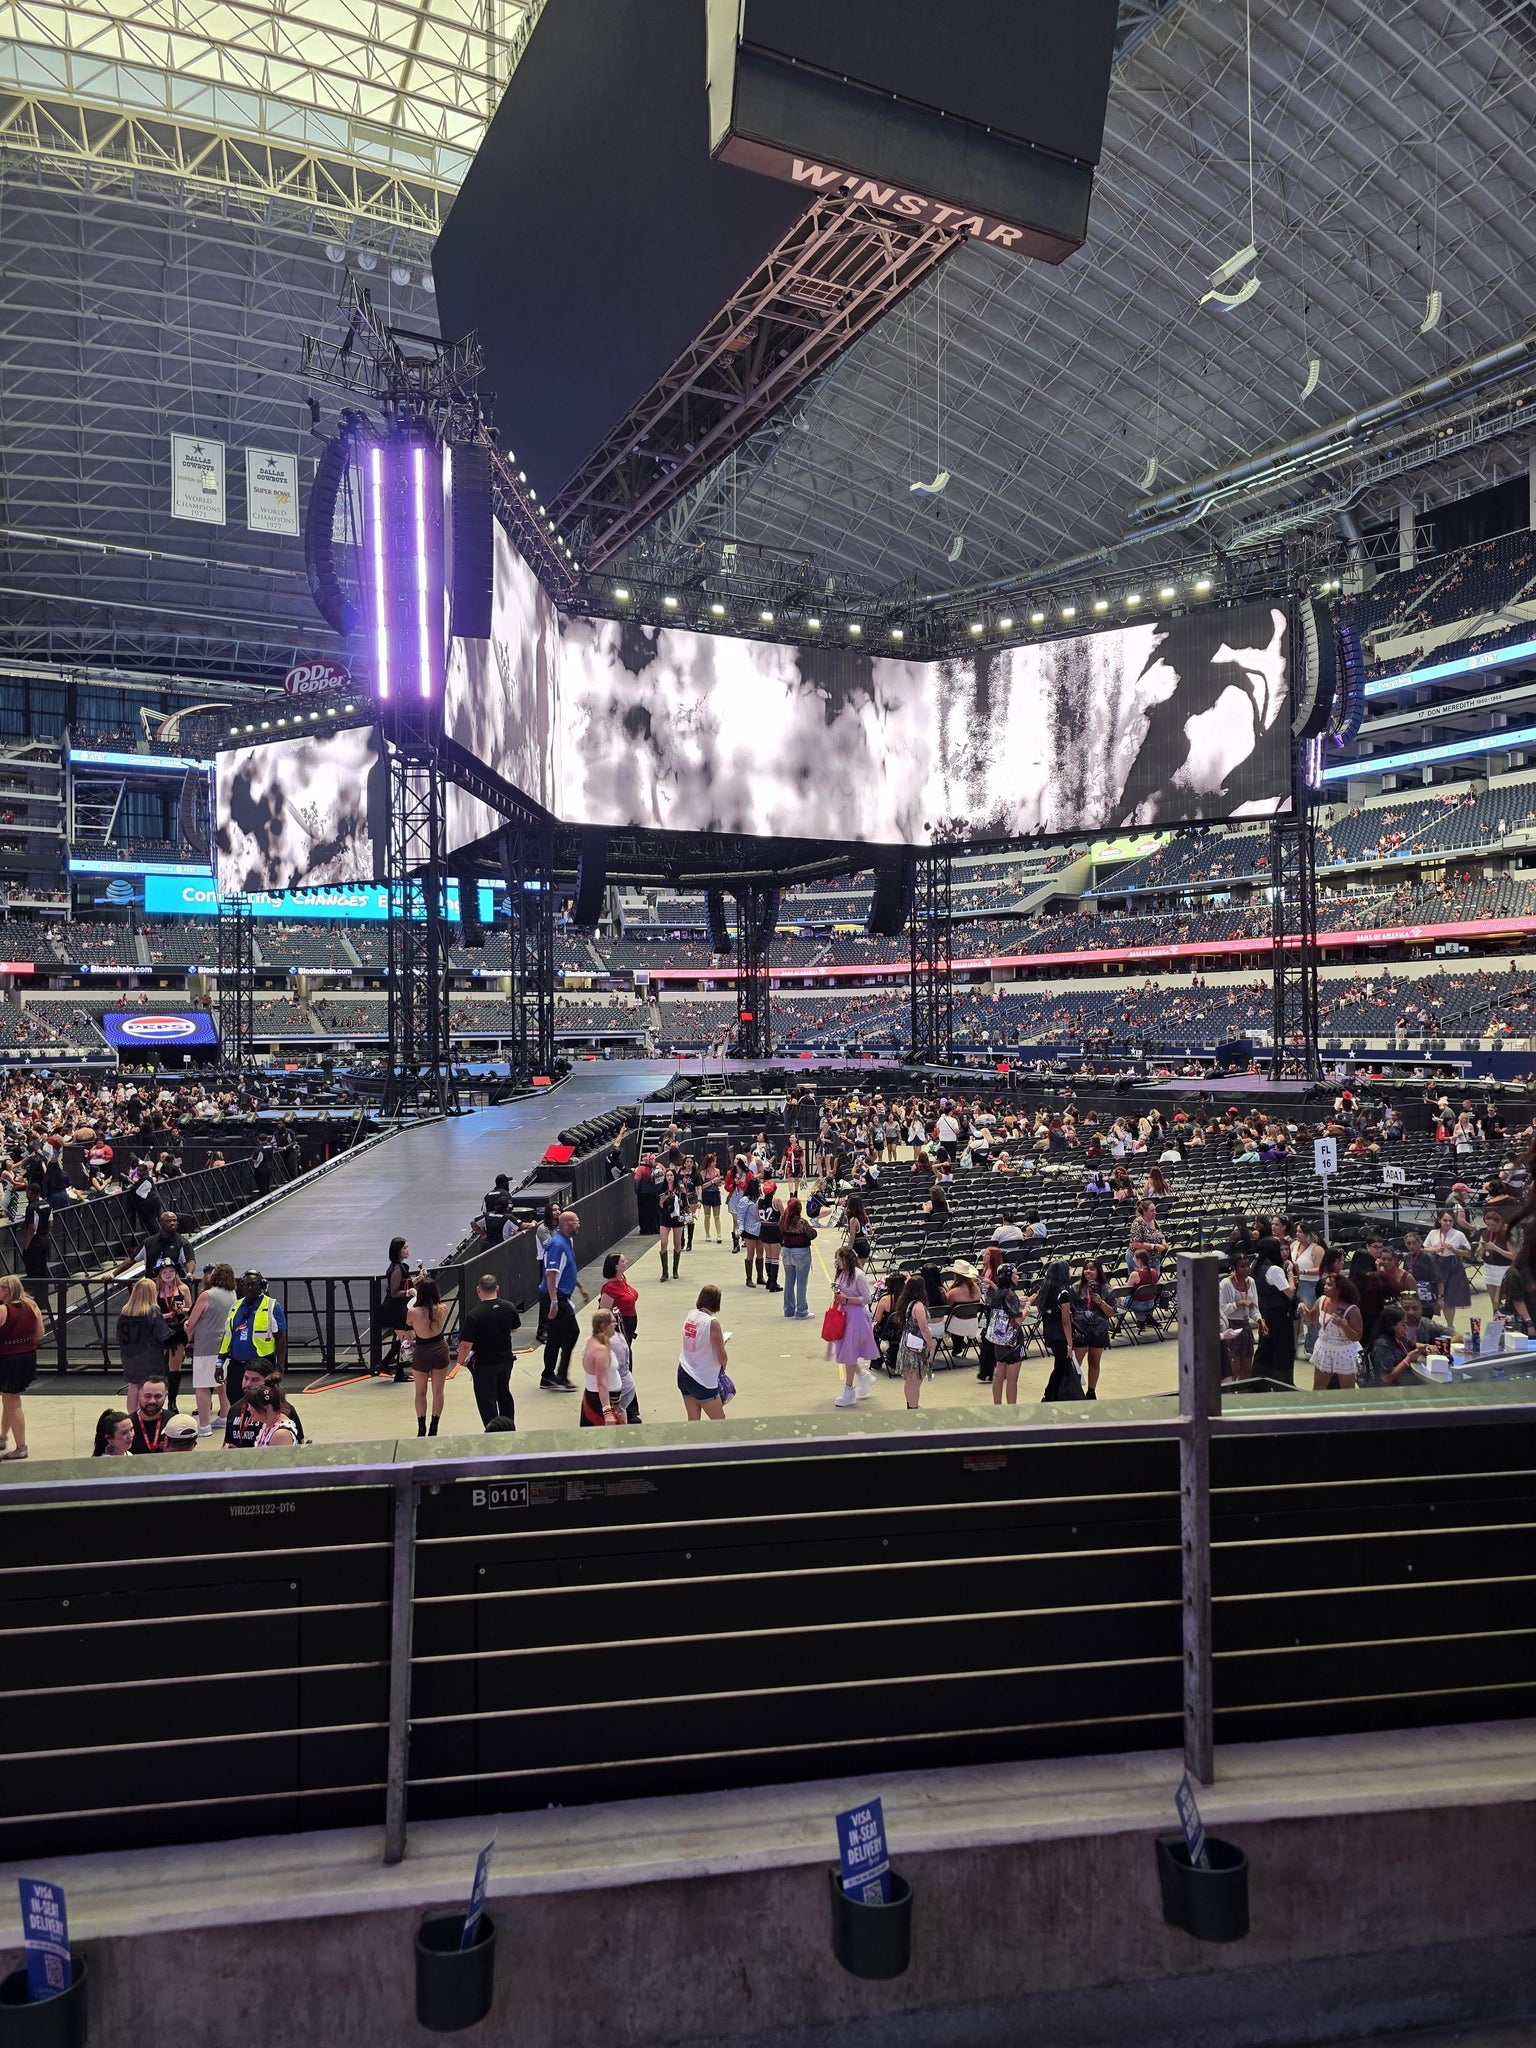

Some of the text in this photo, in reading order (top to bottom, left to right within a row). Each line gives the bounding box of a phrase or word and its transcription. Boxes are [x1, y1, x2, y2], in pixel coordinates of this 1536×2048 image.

[791, 159, 1023, 247] WINSTAR
[182, 461, 214, 471] COWBOYS
[185, 455, 211, 464] DALLAS
[256, 474, 288, 484] COWBOYS
[259, 468, 285, 477] DALLAS
[253, 486, 291, 498] SUPER BOWL
[185, 494, 212, 504] WORLD
[176, 500, 221, 512] CHAMPIONS
[260, 506, 287, 516] WORLD
[191, 509, 207, 517] 1971
[252, 512, 295, 525] CHAMPIONS
[1478, 652, 1498, 665] AT&T
[310, 664, 335, 681] Dr
[285, 666, 347, 694] Pepper
[1377, 675, 1412, 690] Everything
[1418, 711, 1425, 719] 17
[1427, 708, 1441, 718] DON
[1442, 701, 1475, 714] MEREDITH
[292, 891, 369, 907] CHANGES
[90, 965, 152, 973] Blockchain.com
[298, 967, 352, 975] Blockchain.com
[1321, 1145, 1331, 1155] FL
[1322, 1159, 1332, 1169] 16
[1386, 1170, 1402, 1181] ADA1
[232, 1430, 255, 1440] BAKUP
[472, 1489, 486, 1507] B
[491, 1488, 527, 1503] 0101
[229, 1502, 296, 1517] YHD223122-DT6
[851, 1809, 871, 1826] VISA
[848, 1821, 878, 1847] IN-SEAT
[848, 1837, 882, 1865] DELIVERY
[33, 1885, 53, 1899] VISA
[31, 1899, 58, 1917] IN-SEAT
[29, 1913, 64, 1937] DELIVERY
